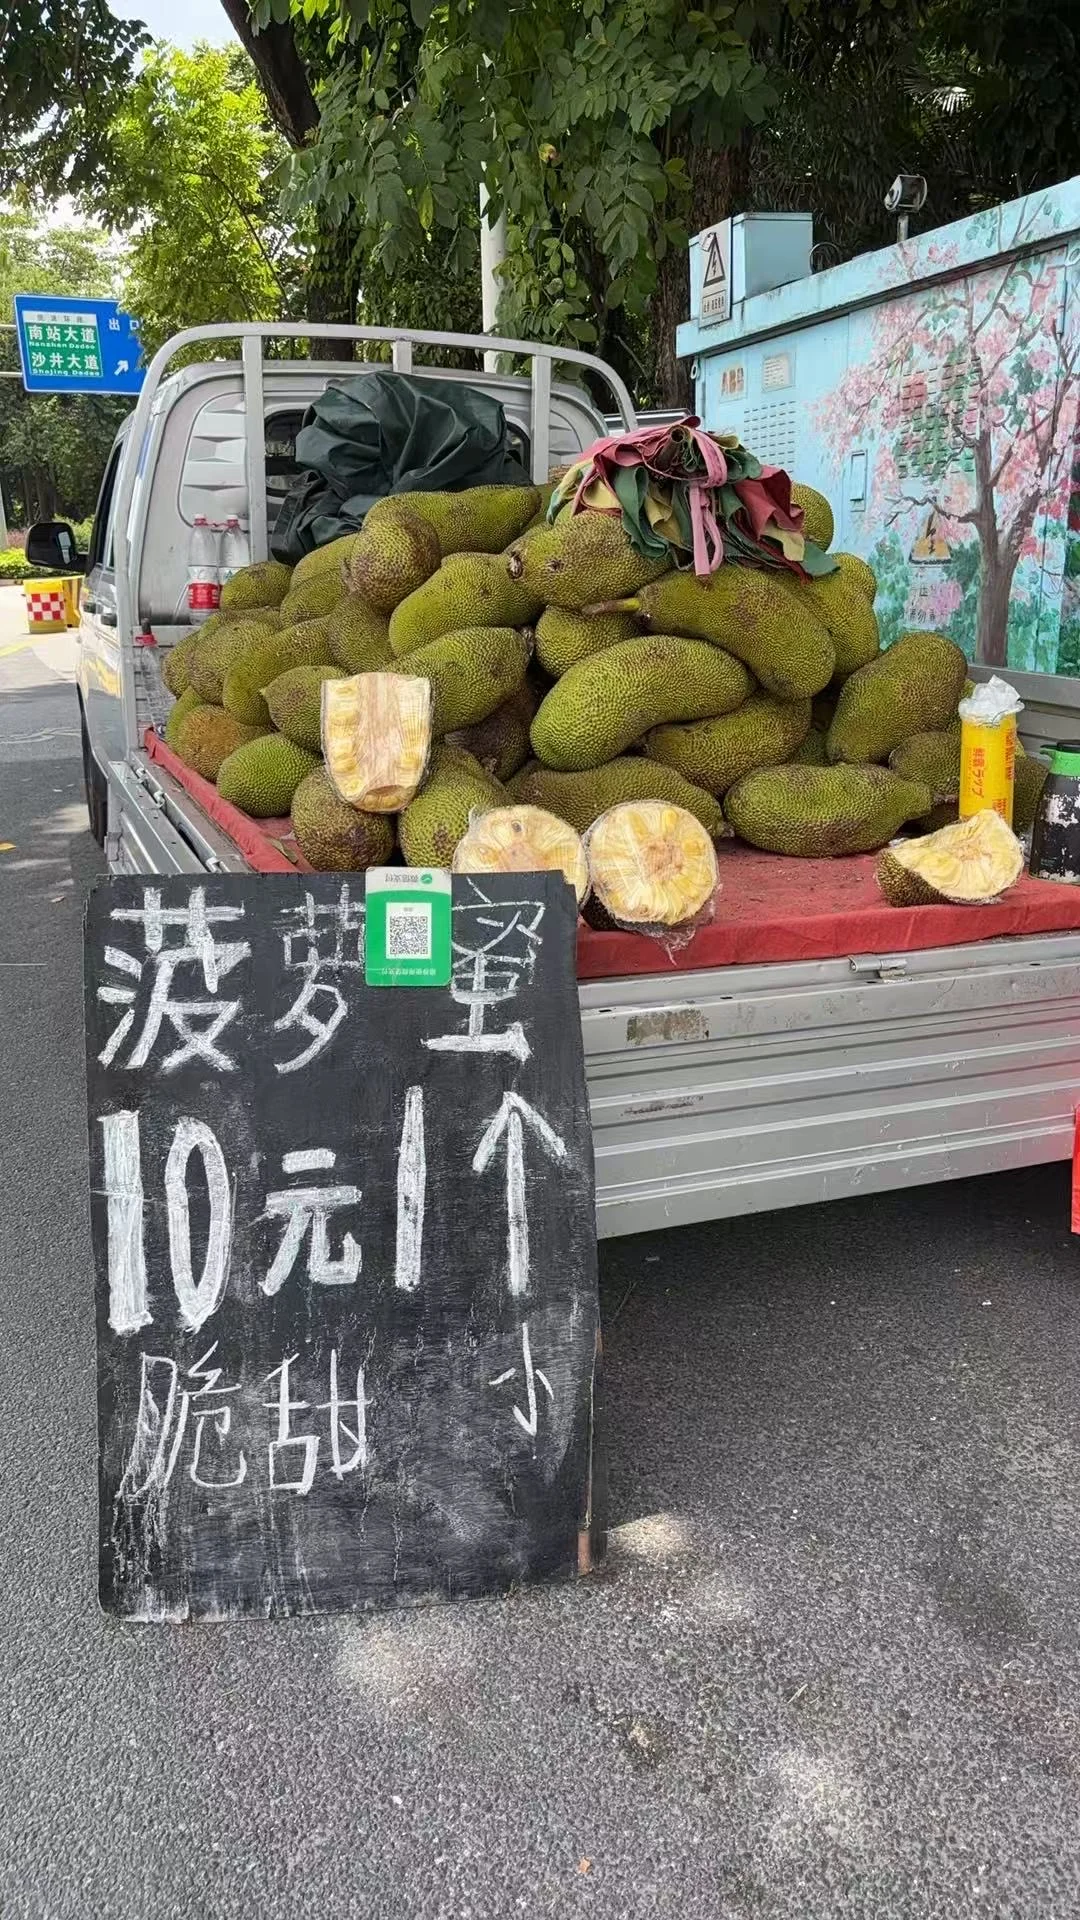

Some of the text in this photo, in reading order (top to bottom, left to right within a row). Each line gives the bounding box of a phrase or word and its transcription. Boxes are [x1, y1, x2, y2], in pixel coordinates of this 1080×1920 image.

[108, 317, 139, 331] 出口
[28, 325, 96, 343] 南站大道
[31, 352, 99, 370] 沙井大道
[97, 877, 546, 1073] 菠萝蜜
[115, 1340, 373, 1498] 脆甜
